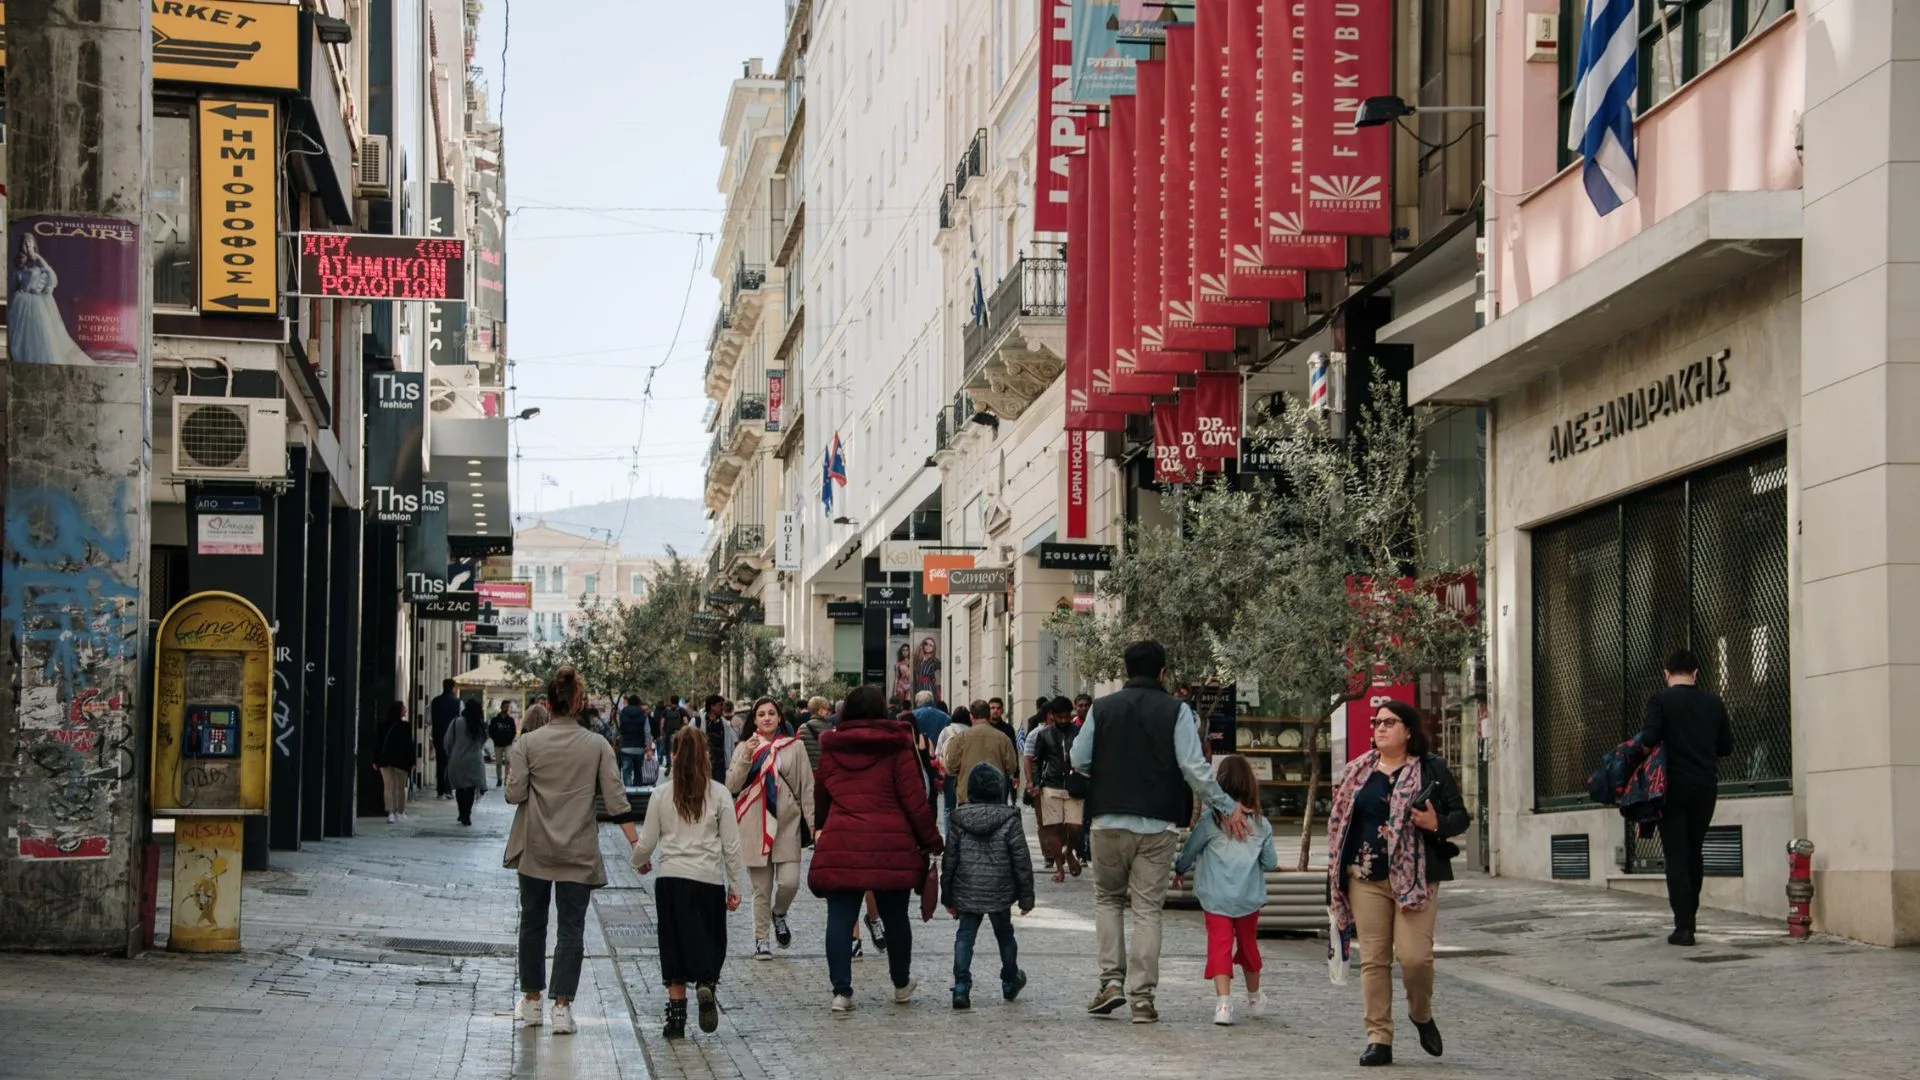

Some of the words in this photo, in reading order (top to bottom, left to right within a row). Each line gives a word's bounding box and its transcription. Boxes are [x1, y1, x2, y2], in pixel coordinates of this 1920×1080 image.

[220, 130, 256, 284] ΗΜΙΟΡΟΦΟΣ
[1309, 200, 1381, 209] FUNKYBUDDHA
[34, 221, 136, 242] CLAIRE
[1269, 235, 1337, 243] FUNKYBUDDHA
[372, 374, 420, 400] Ths
[379, 400, 413, 410] fashion
[1548, 347, 1732, 465] ΑΛΕΞΑΝΔΡΑΚΗΣ
[1072, 430, 1083, 469] HOUSE
[422, 484, 445, 505] hs
[1072, 470, 1083, 506] LAPIN
[371, 486, 418, 512] Ths
[378, 512, 412, 522] fashion
[784, 515, 793, 562] HOTEL
[406, 572, 445, 593] Ths
[950, 571, 1005, 584] Cameo's
[412, 593, 439, 601] fashion
[491, 590, 527, 599] woman
[447, 601, 471, 612] ZAC
